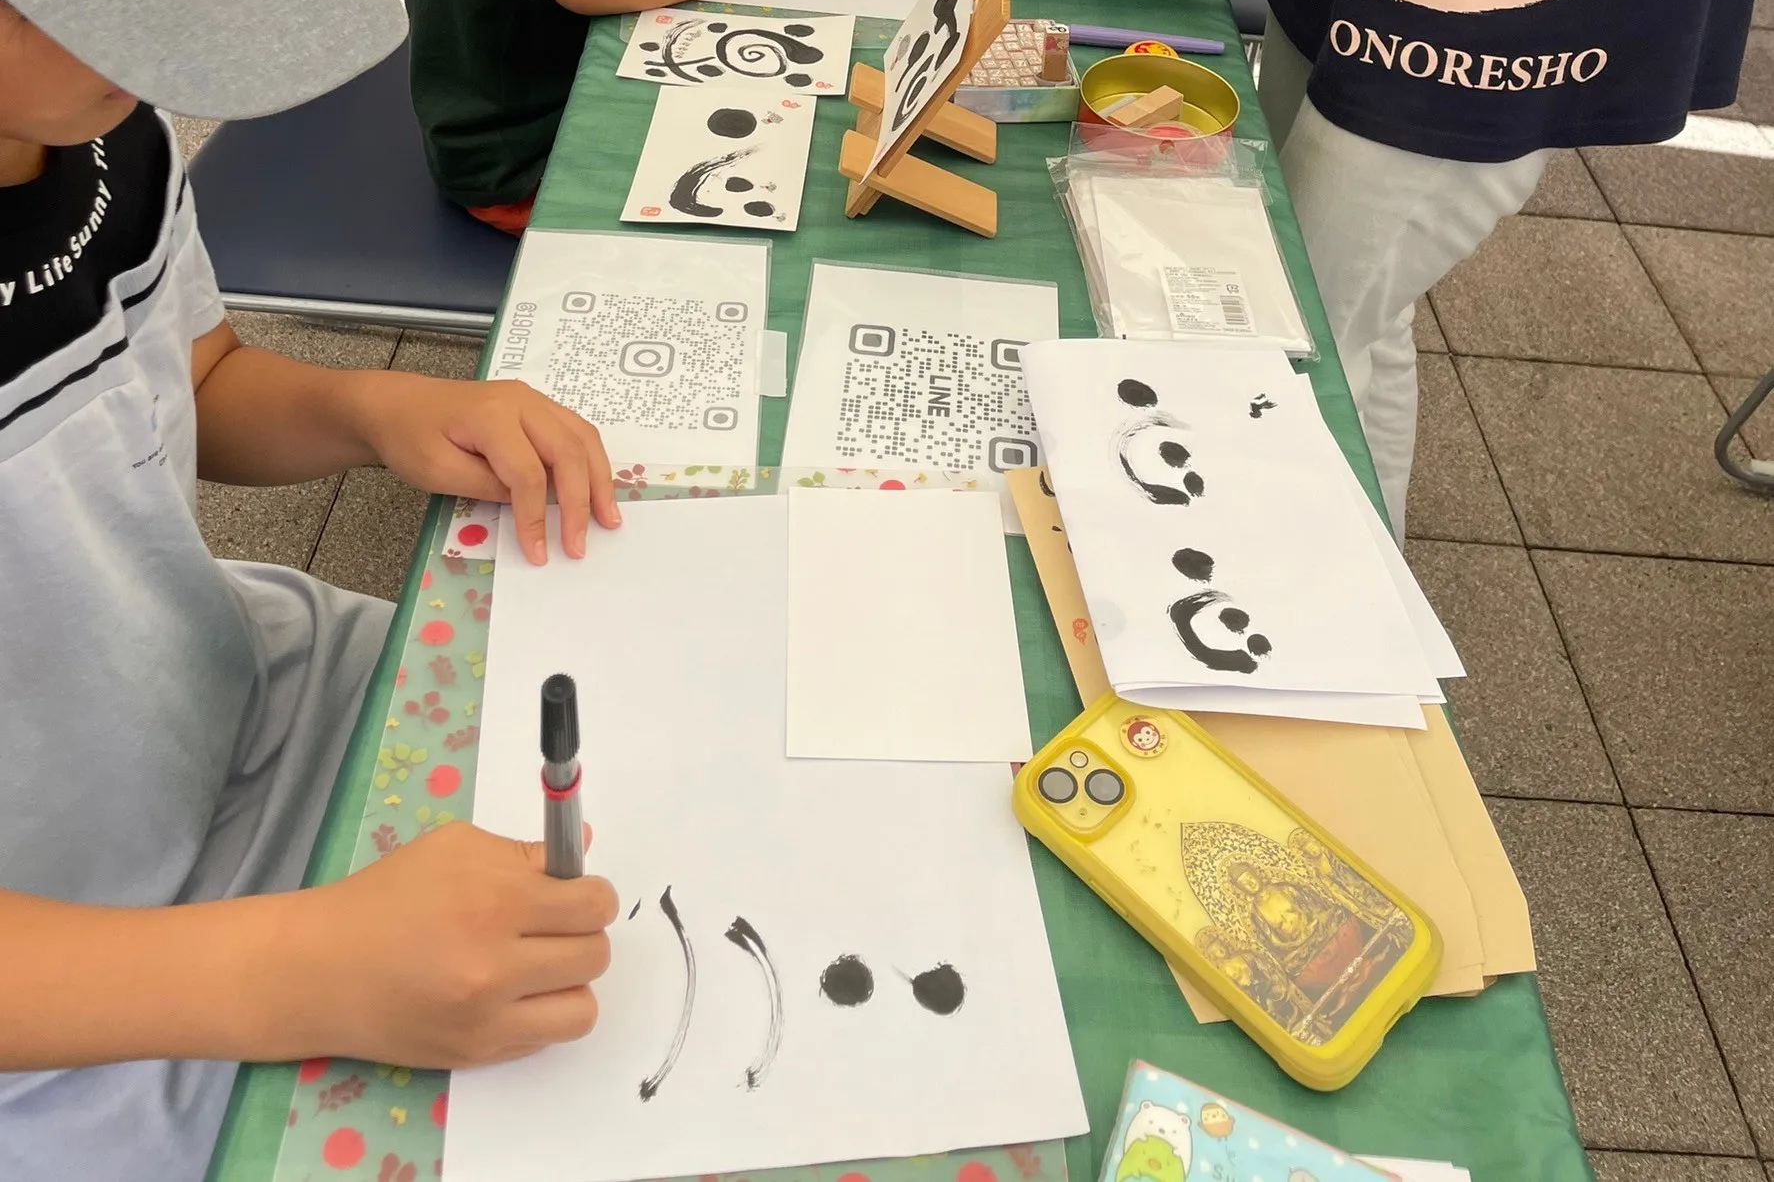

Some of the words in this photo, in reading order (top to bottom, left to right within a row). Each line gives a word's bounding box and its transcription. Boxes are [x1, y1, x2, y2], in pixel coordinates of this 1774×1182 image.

[1329, 19, 1608, 91] ONORESHO
[27, 255, 74, 295] Life
[70, 178, 112, 259] Sunny
[928, 374, 952, 418] LINE
